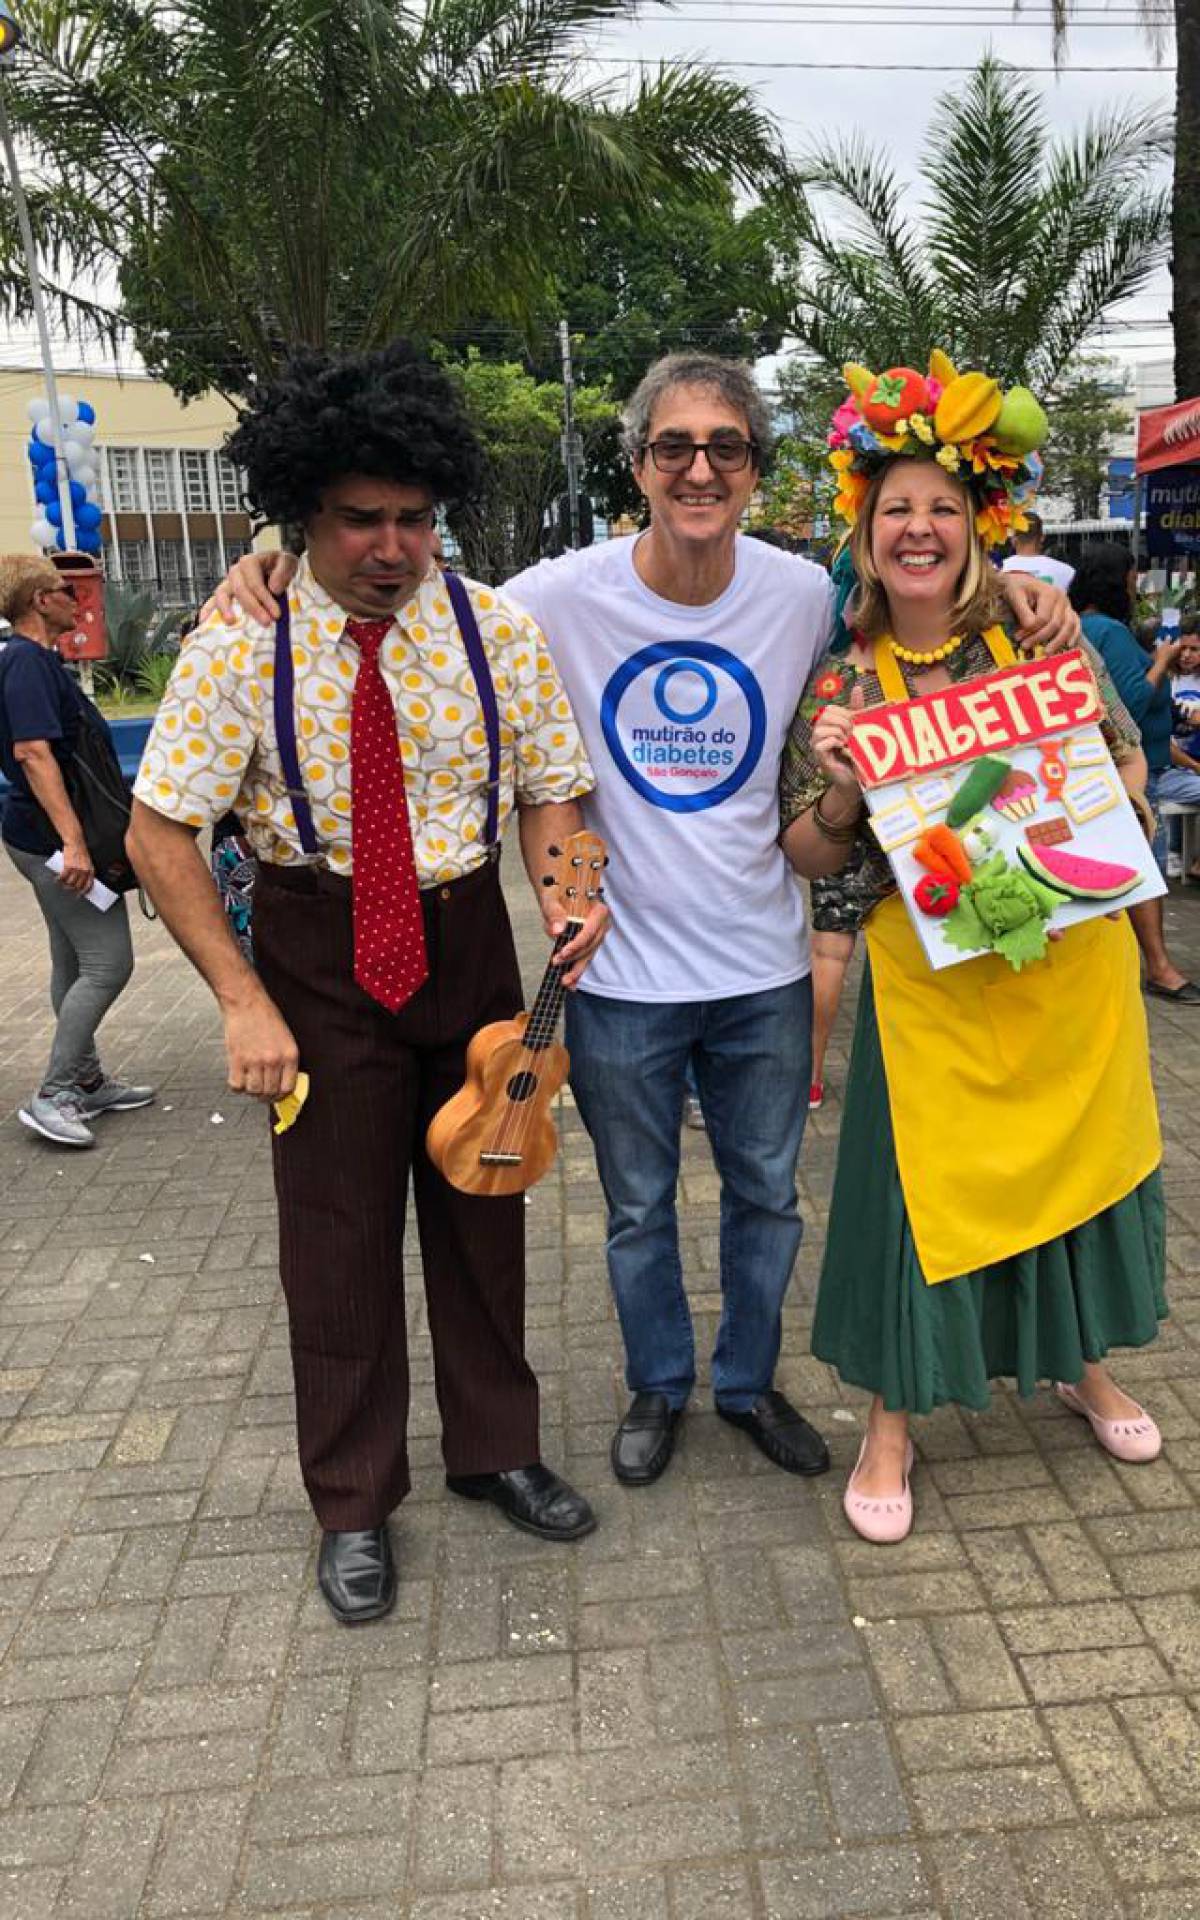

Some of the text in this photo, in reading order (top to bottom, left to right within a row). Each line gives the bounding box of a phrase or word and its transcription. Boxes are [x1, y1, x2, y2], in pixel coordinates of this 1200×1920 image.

[1151, 485, 1200, 504] muti
[632, 726, 736, 744] mutirão do
[632, 742, 735, 765] diabetes
